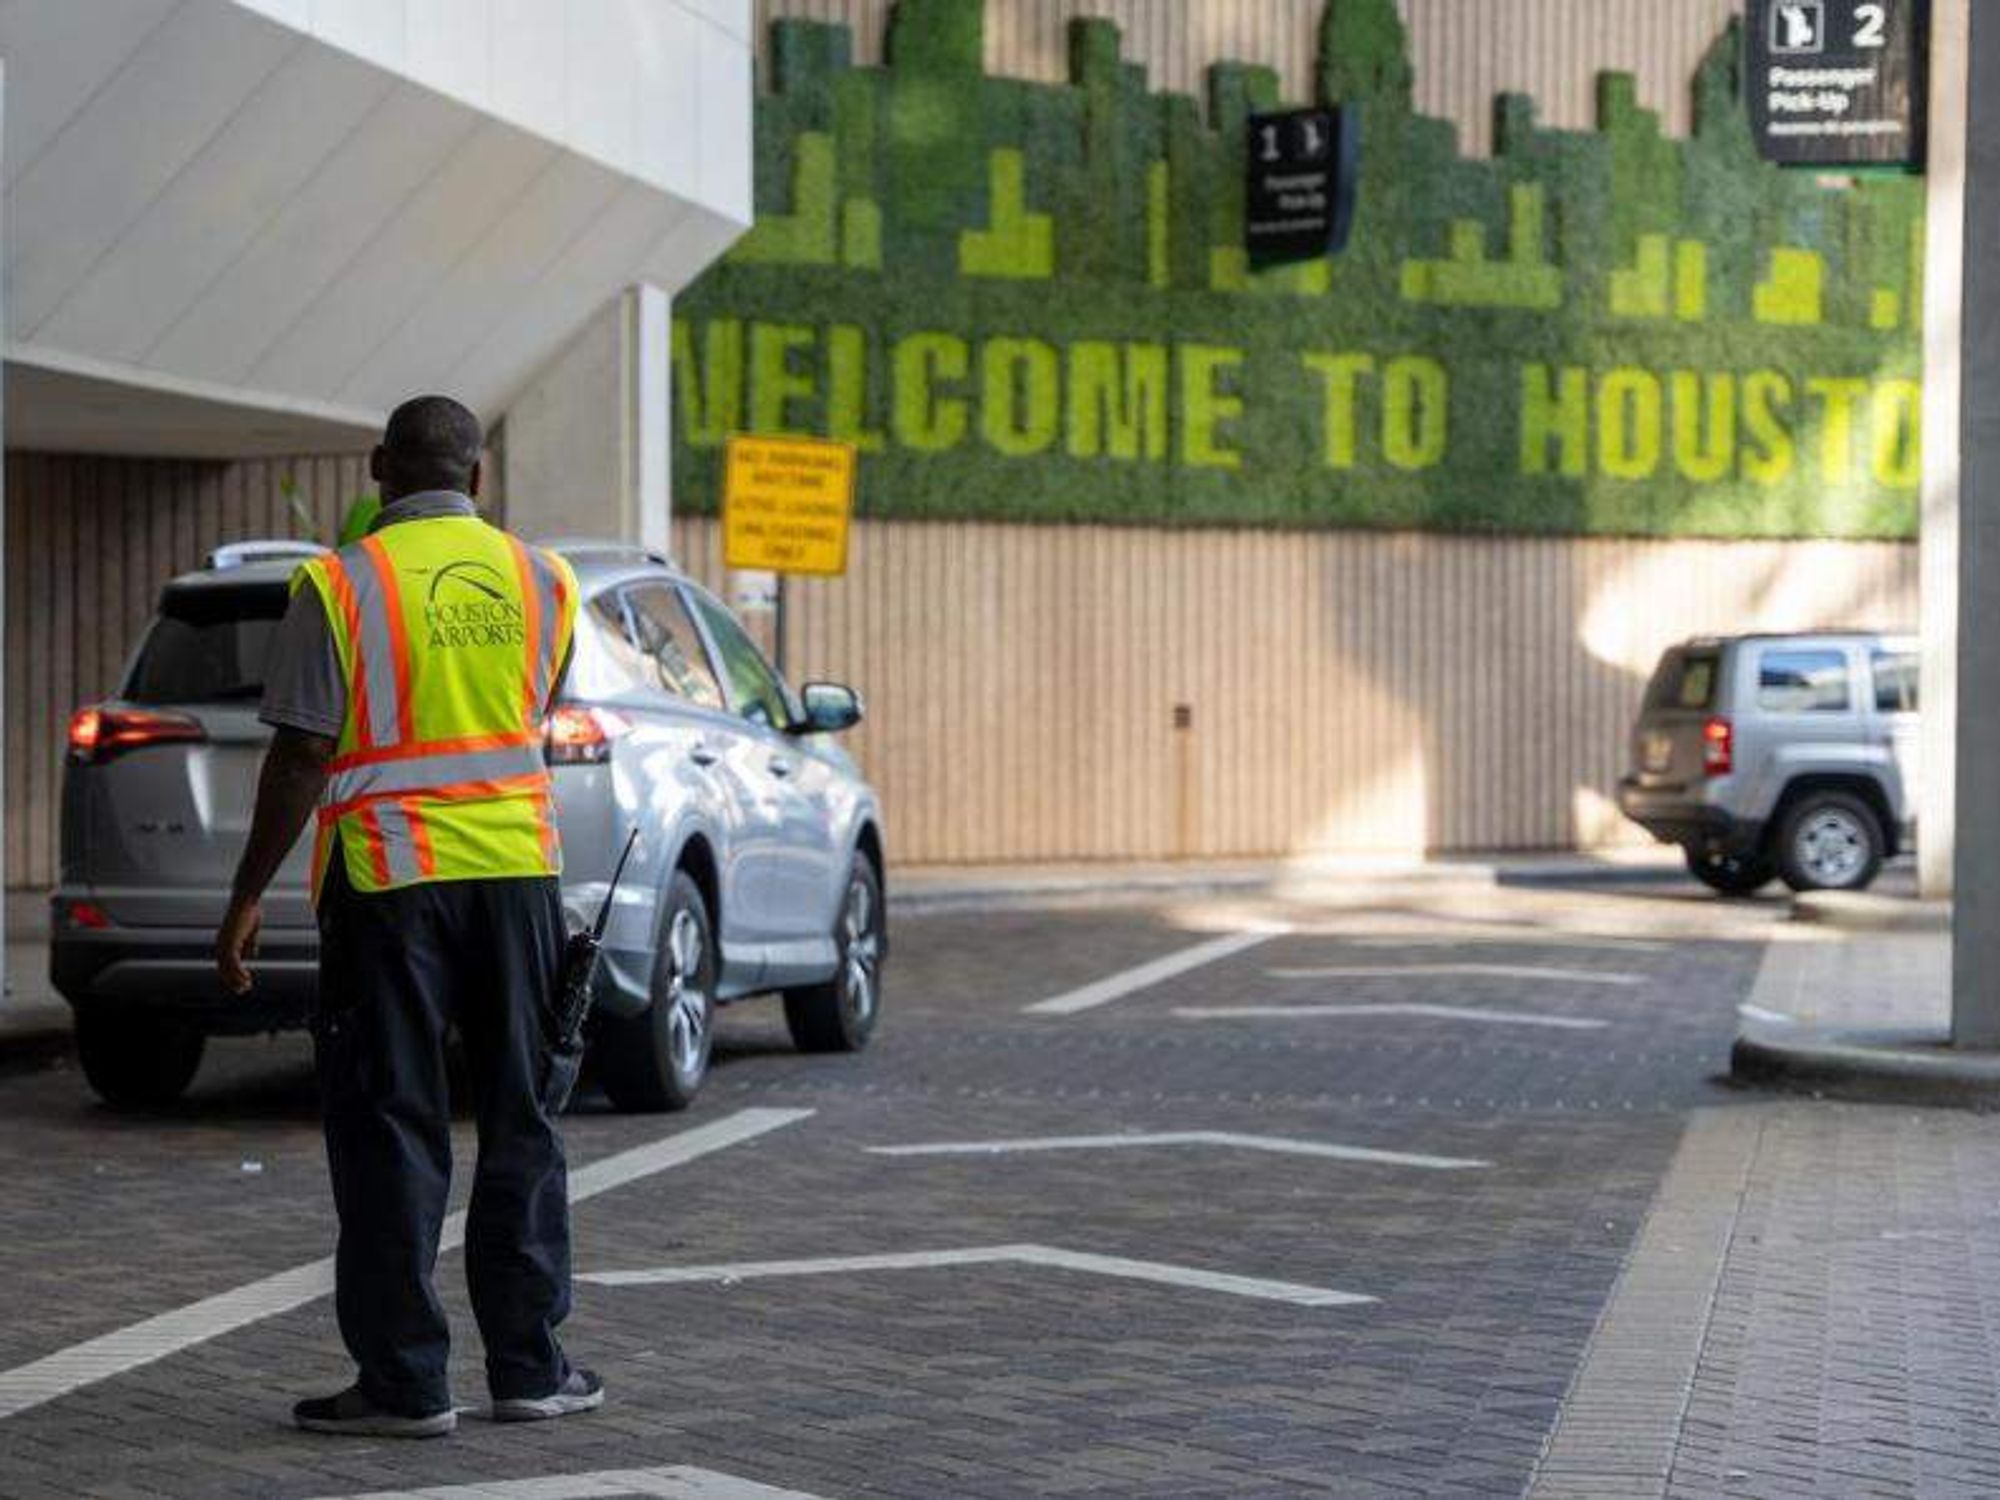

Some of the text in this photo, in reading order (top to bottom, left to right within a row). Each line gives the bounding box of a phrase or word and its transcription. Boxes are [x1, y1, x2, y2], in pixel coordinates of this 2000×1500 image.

[1853, 4, 1885, 46] 2
[1769, 66, 1877, 90] Passenger
[1261, 125, 1281, 161] 1
[1303, 352, 1447, 470] TO
[424, 600, 522, 626] HOUSTON
[428, 623, 524, 648] AIRPORTS
